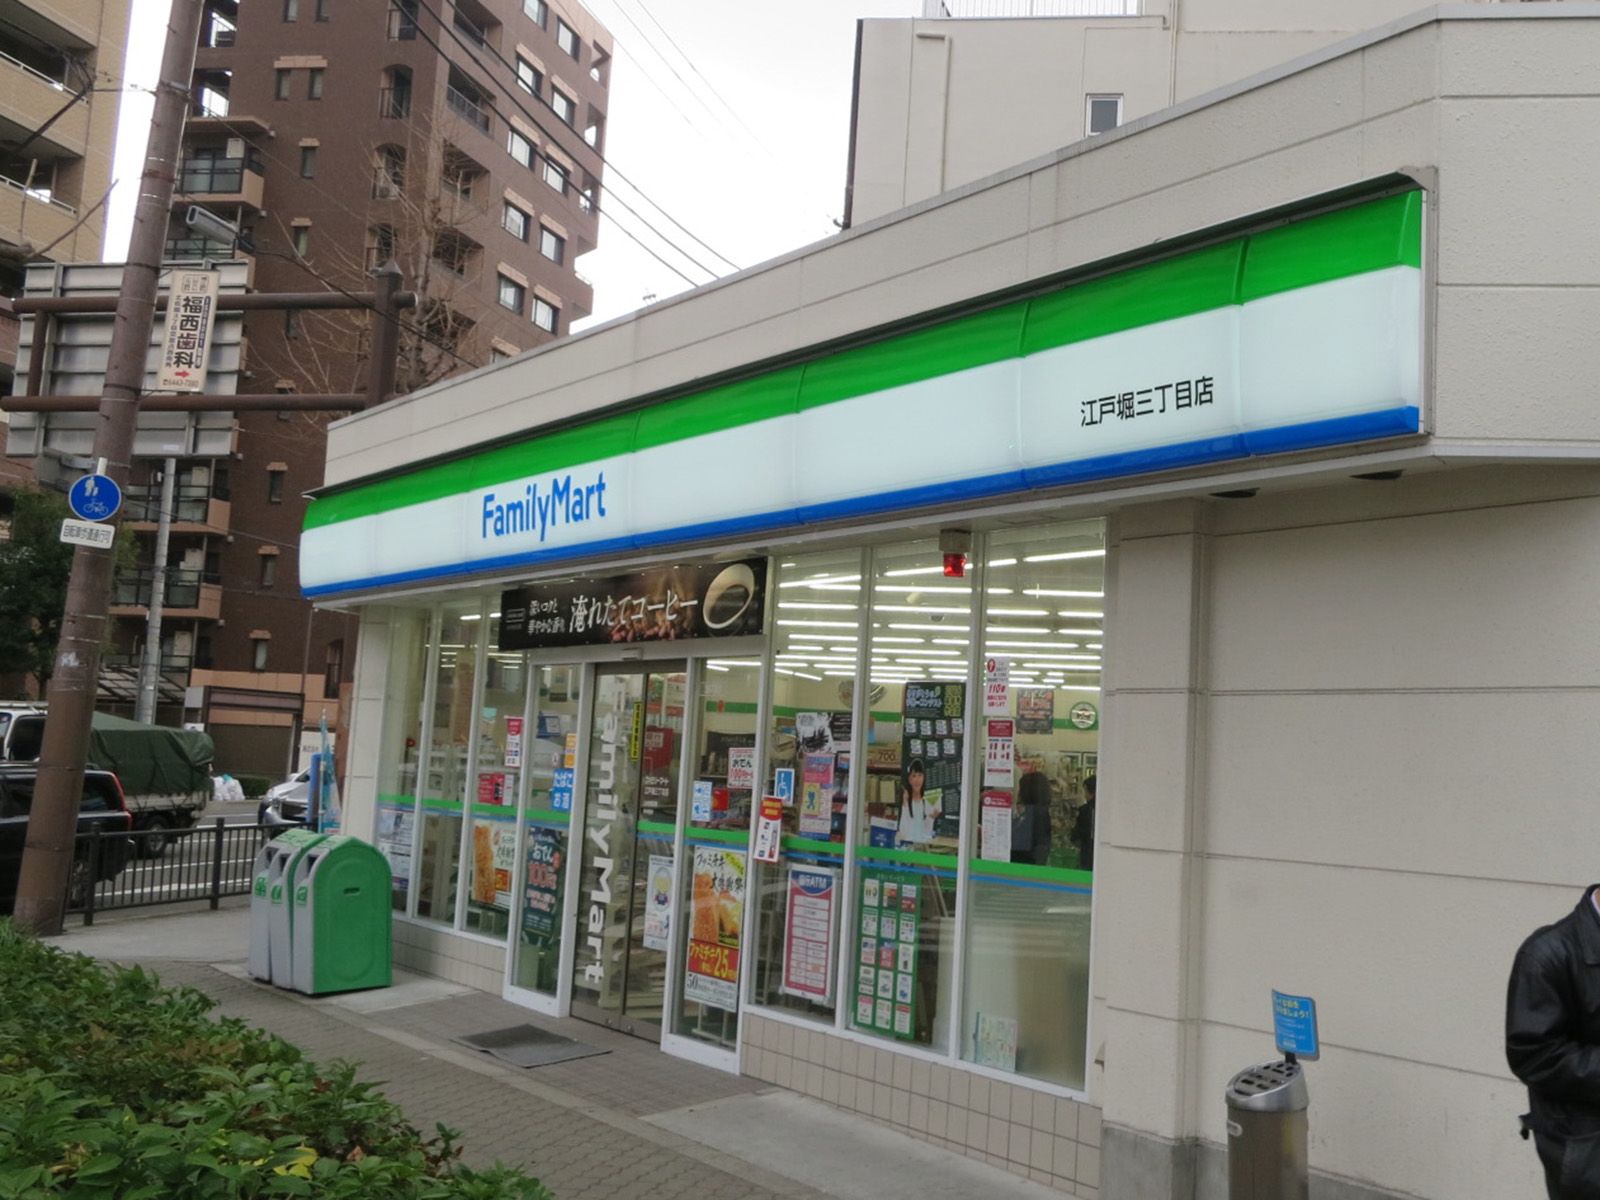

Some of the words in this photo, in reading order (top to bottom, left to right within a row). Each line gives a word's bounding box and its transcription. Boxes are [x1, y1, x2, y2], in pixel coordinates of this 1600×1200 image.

[173, 296, 204, 368] 福西歯科
[1080, 376, 1214, 427] 江戸堀三丁目店
[482, 471, 606, 541] FamilyMart
[569, 590, 698, 633] 淹れたてコーヒー
